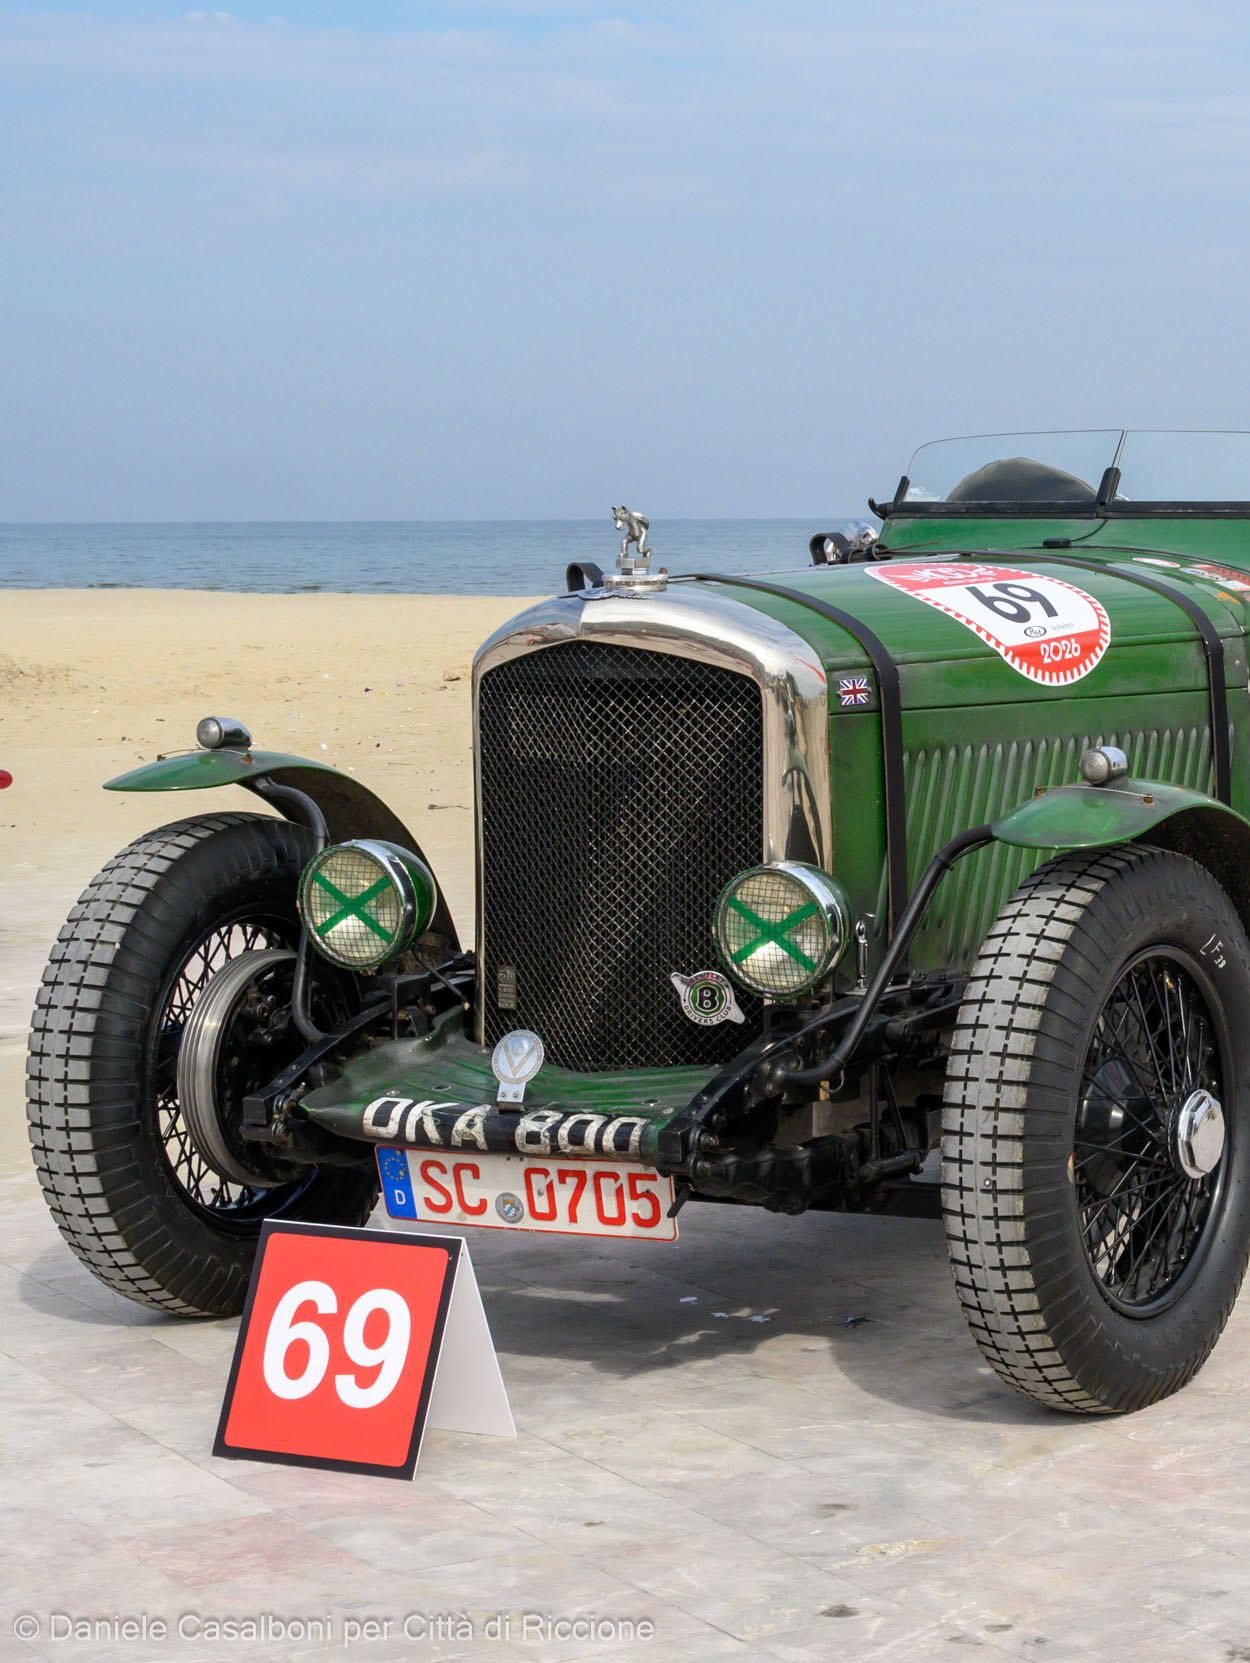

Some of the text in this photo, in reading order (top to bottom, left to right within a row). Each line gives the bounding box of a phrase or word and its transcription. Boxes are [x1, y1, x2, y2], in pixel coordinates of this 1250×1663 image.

[965, 582, 1058, 624] 69
[1040, 638, 1081, 665] 2026
[696, 985, 720, 1012] B
[684, 1006, 732, 1023] DRIVERS CLUB
[394, 1189, 407, 1205] D
[419, 1159, 662, 1229] SC 0705
[263, 1280, 411, 1409] 69
